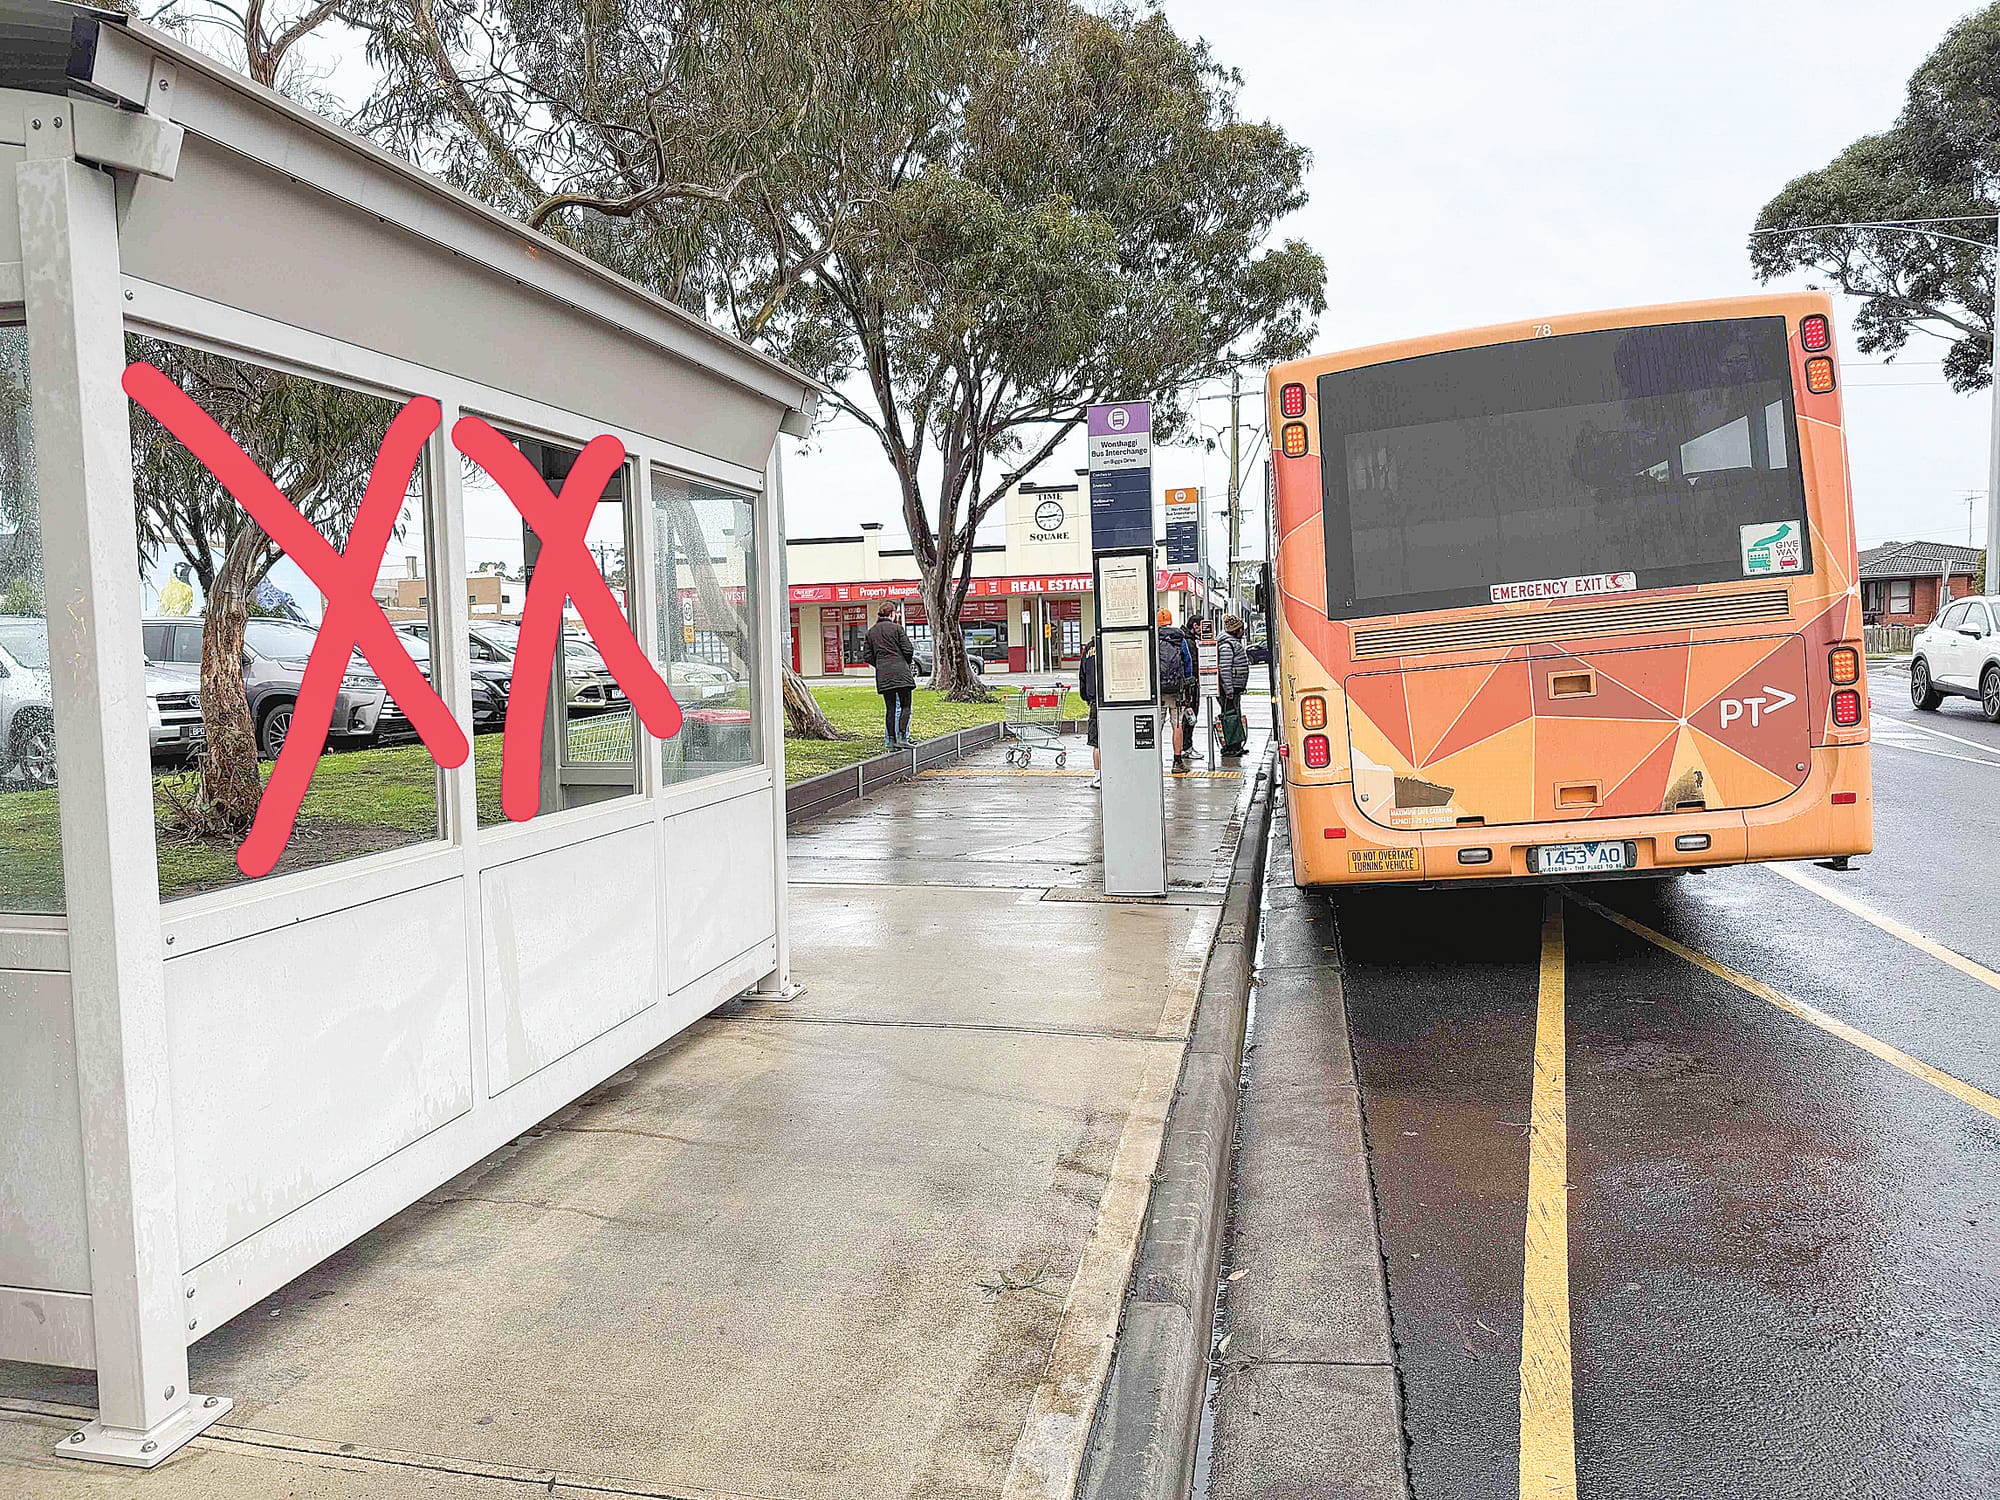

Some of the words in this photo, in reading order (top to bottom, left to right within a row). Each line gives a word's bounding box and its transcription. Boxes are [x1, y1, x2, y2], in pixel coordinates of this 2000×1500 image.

[1532, 324, 1552, 337] 78
[1101, 439, 1138, 448] Wonthaggi
[1091, 450, 1104, 458] Bus
[1105, 448, 1148, 456] Interchange
[1036, 493, 1063, 501] TIME
[1030, 532, 1070, 541] SQUARE
[1775, 540, 1799, 549] GIVE
[1776, 548, 1799, 556] WAY
[859, 587, 887, 598] Property
[888, 585, 920, 597] Managem
[1011, 580, 1044, 593] REAL
[1048, 578, 1094, 592] ESTATE
[1492, 580, 1568, 601] EMERGENCY
[1575, 577, 1602, 592] EXIT
[1352, 852, 1361, 861] DO
[1363, 851, 1376, 861] NOT
[1378, 849, 1414, 861] OVERTAKE
[1545, 850, 1587, 866] 1453
[1353, 861, 1383, 871] TURNING
[1385, 859, 1414, 870] VEHICLE
